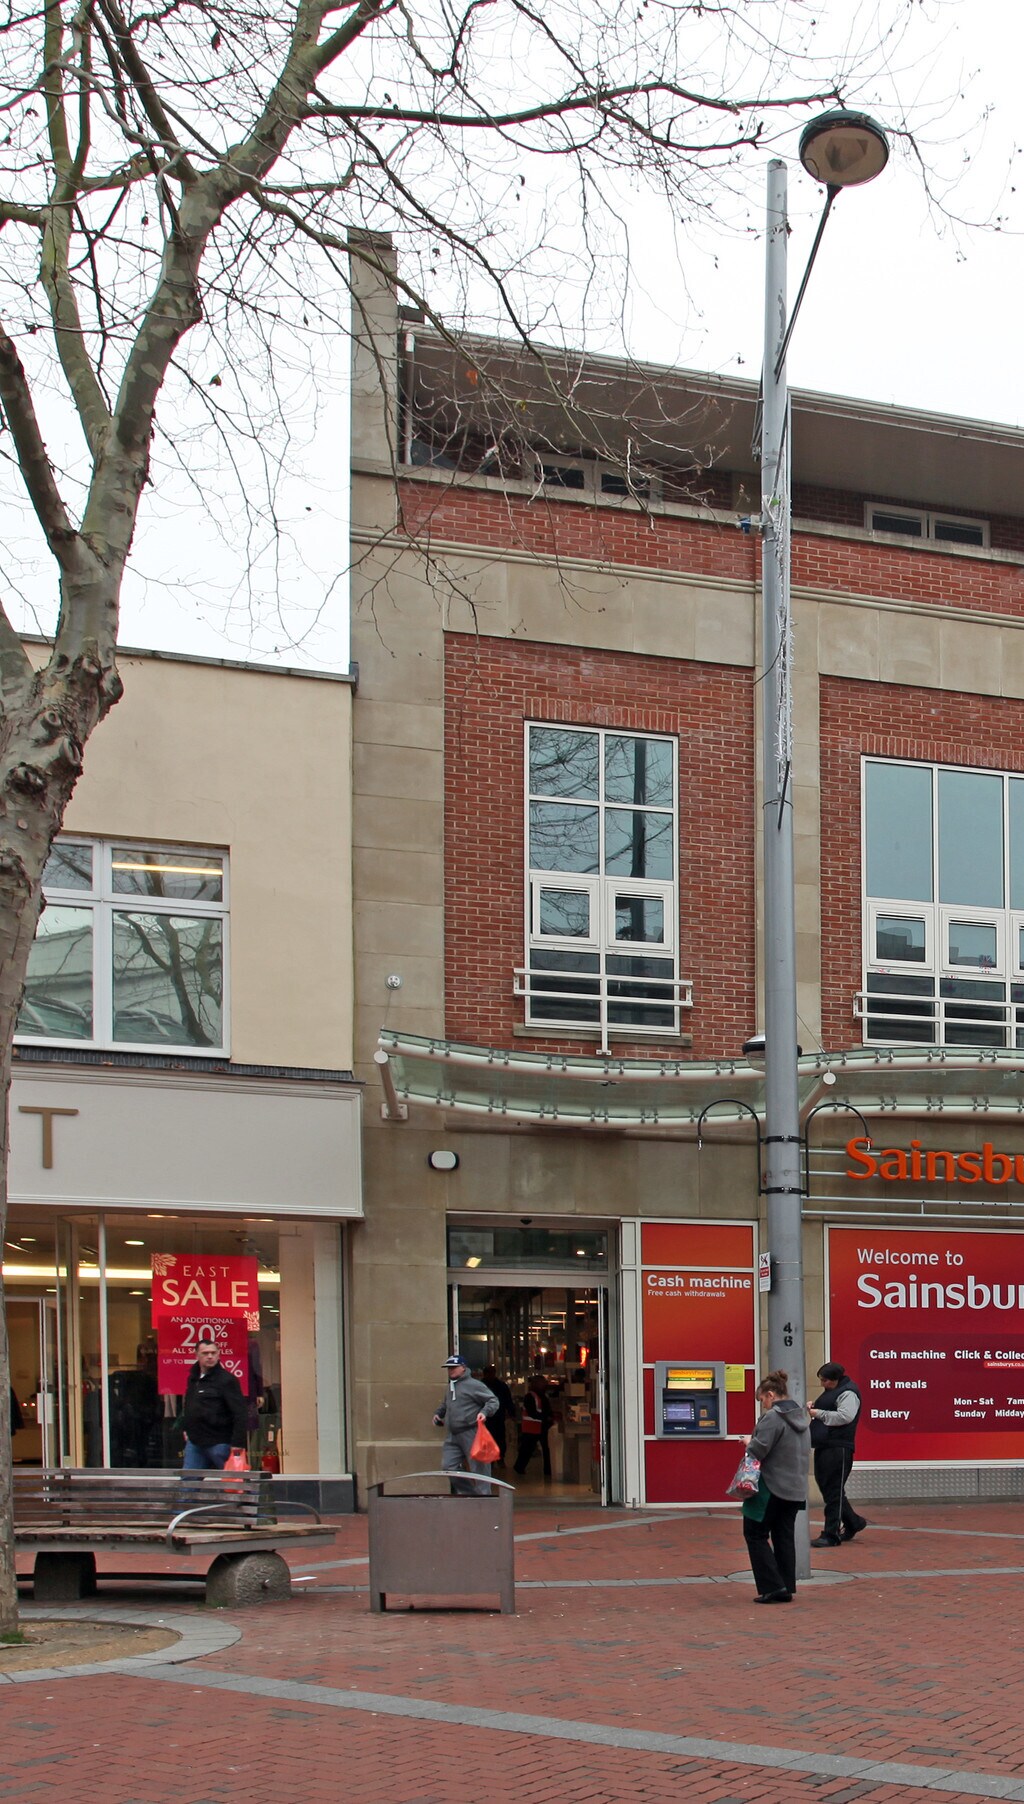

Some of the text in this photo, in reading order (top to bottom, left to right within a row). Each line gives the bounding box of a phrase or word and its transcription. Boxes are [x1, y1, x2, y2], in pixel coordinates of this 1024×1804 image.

[857, 1248, 964, 1266] Welcome to
[183, 1265, 230, 1278] EAST
[647, 1274, 685, 1288] Cash
[689, 1275, 752, 1289] machine
[162, 1279, 250, 1308] SALE
[647, 1289, 726, 1298] Free cash withdrawals
[185, 1316, 234, 1325] ADDITIONAL
[869, 1349, 946, 1359] Cash machine
[954, 1350, 981, 1359] Click
[983, 1350, 992, 1360] &
[870, 1379, 927, 1389] Hot meals
[870, 1408, 910, 1420] Bakery
[954, 1409, 986, 1419] Sunday
